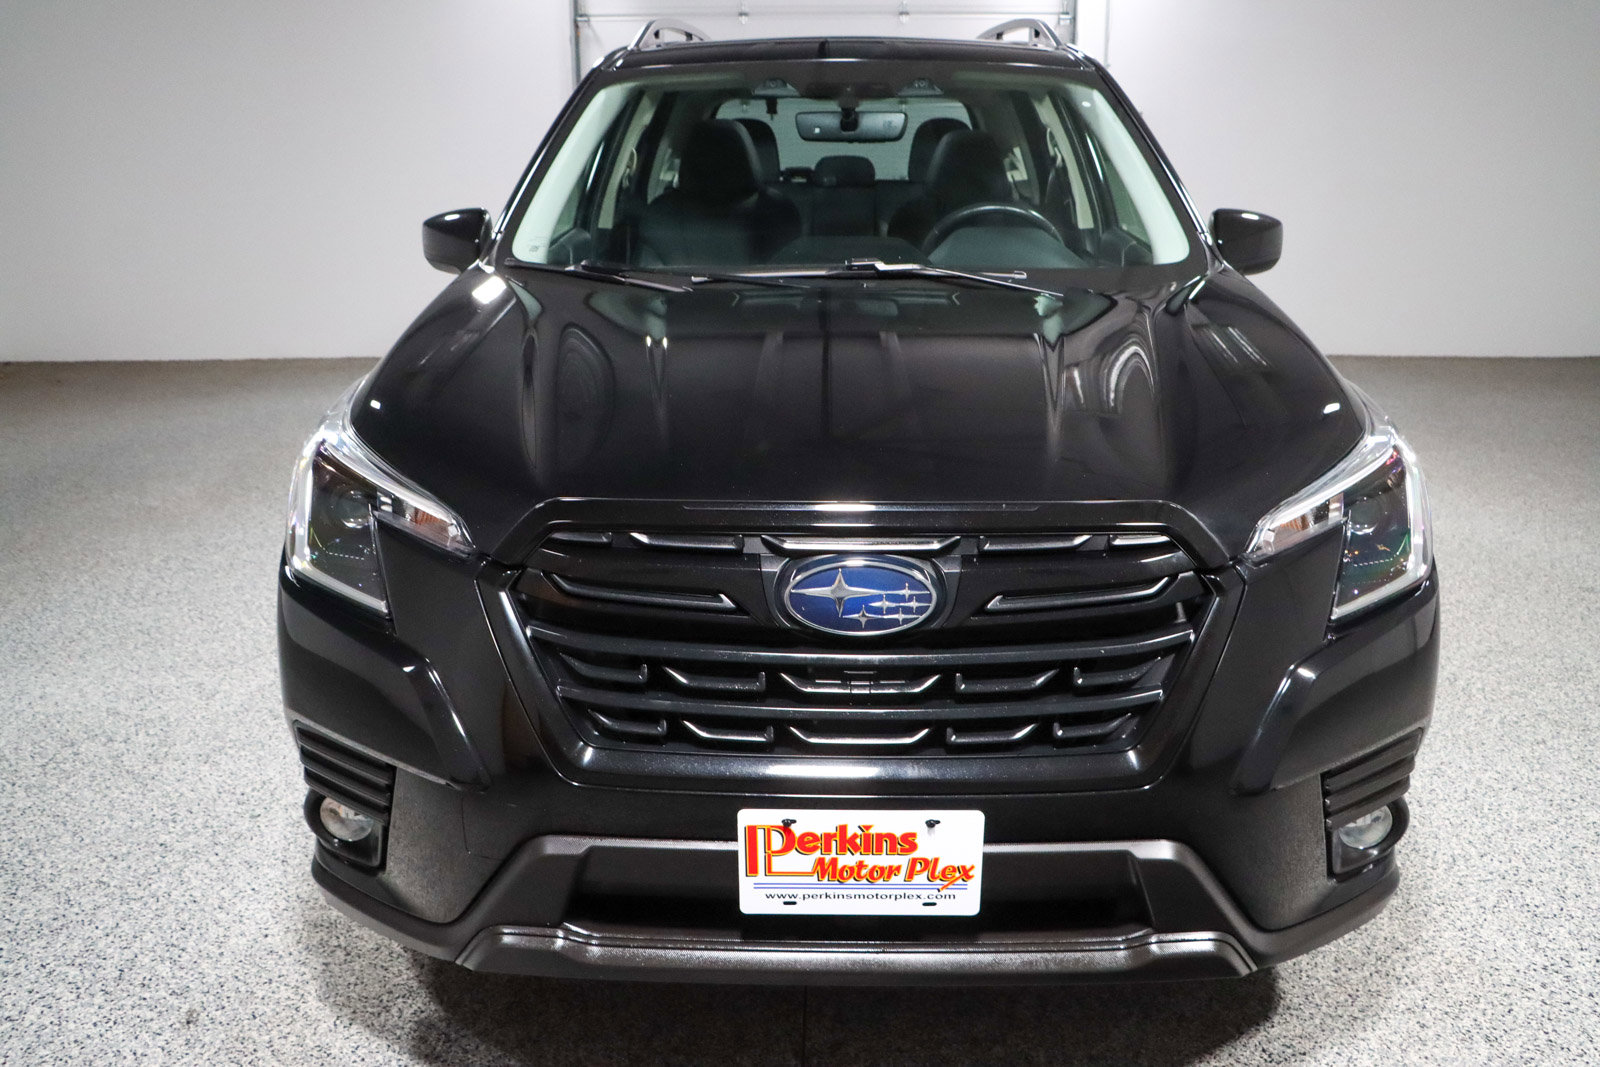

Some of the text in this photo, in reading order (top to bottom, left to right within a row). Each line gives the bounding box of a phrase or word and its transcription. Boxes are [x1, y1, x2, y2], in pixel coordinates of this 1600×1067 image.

[745, 824, 919, 876] Perkins
[812, 857, 976, 892] Motor Plex
[765, 892, 956, 901] www.perkinsmotorplex.com
